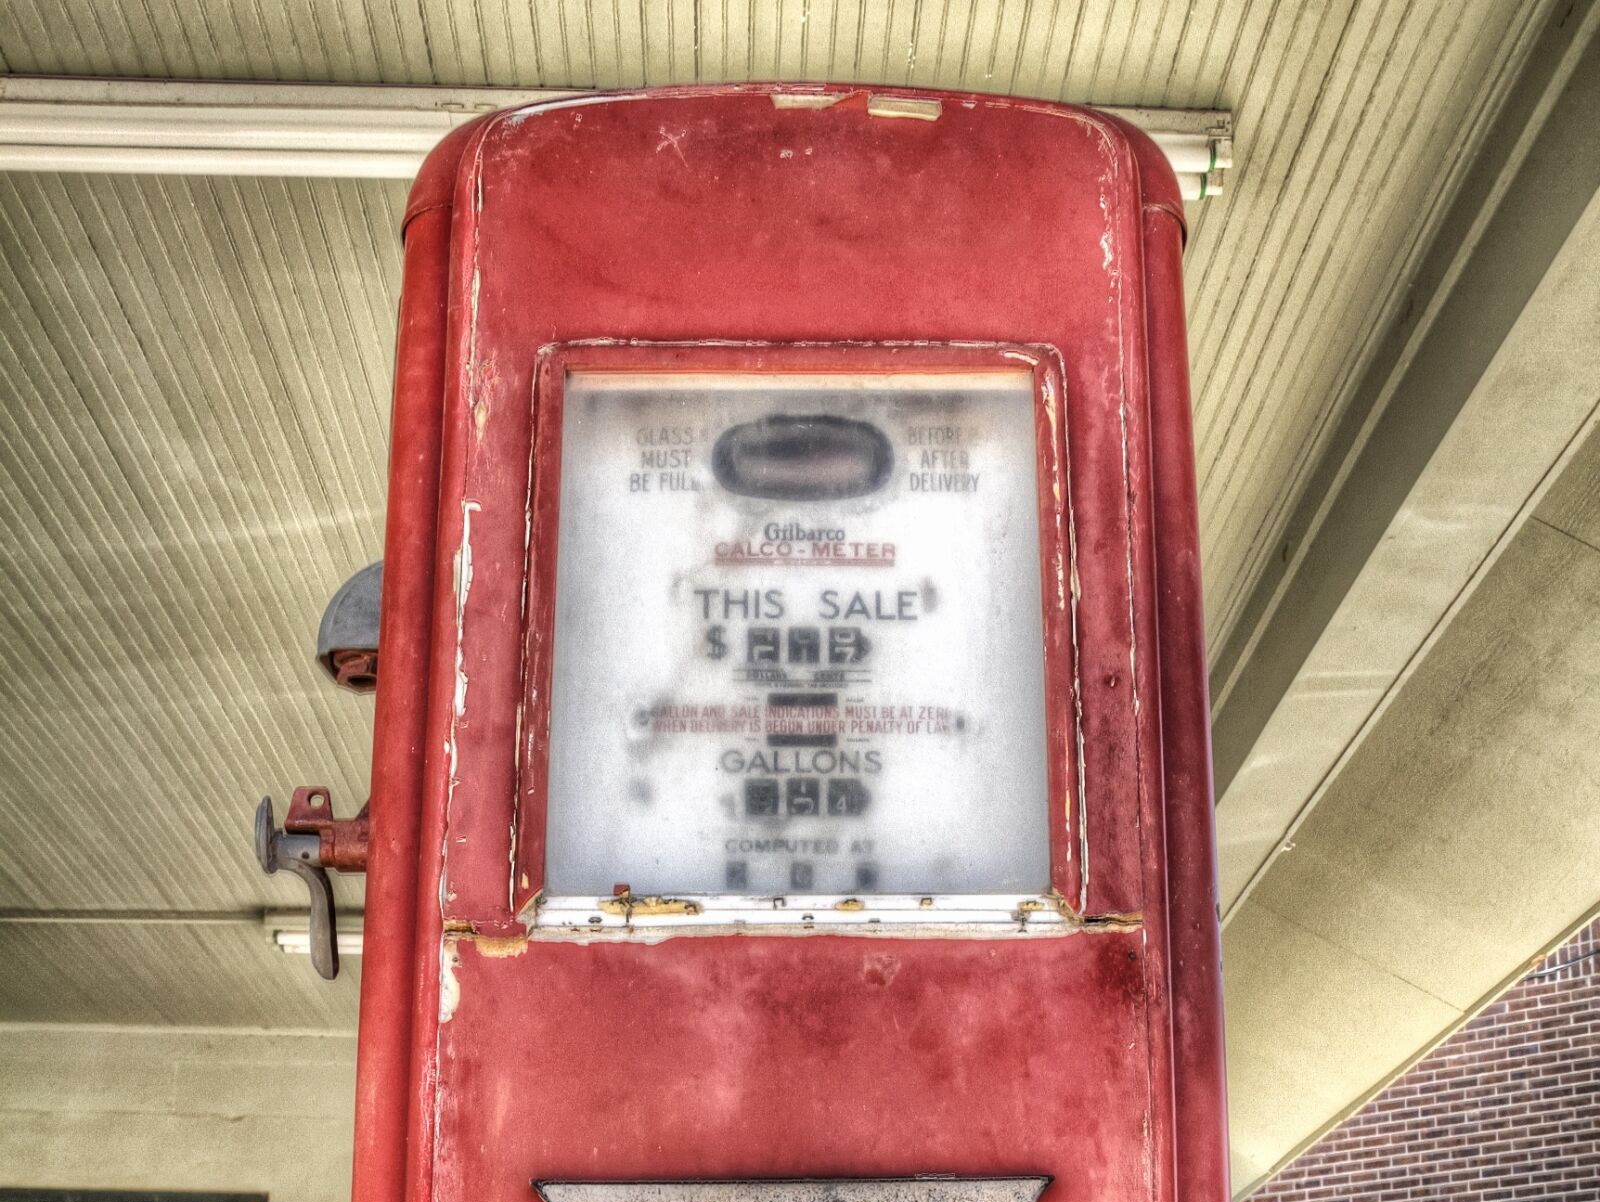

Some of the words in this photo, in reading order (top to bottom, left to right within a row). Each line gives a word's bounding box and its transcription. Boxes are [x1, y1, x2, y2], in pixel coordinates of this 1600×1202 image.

[636, 427, 694, 446] GLASS
[641, 449, 692, 469] MUST
[920, 449, 970, 469] AFTER
[629, 473, 651, 492] BE
[909, 472, 980, 492] DELIVERY
[764, 522, 845, 541] Gilbarco
[694, 589, 784, 619] THIS
[819, 590, 918, 621] SALE
[845, 705, 877, 720] MUST
[900, 706, 914, 720] AT
[749, 719, 761, 733] IS
[850, 720, 902, 734] PENALTY
[906, 720, 922, 735] OF
[720, 750, 882, 774] GALLONS
[725, 839, 839, 854] COMPUTED
